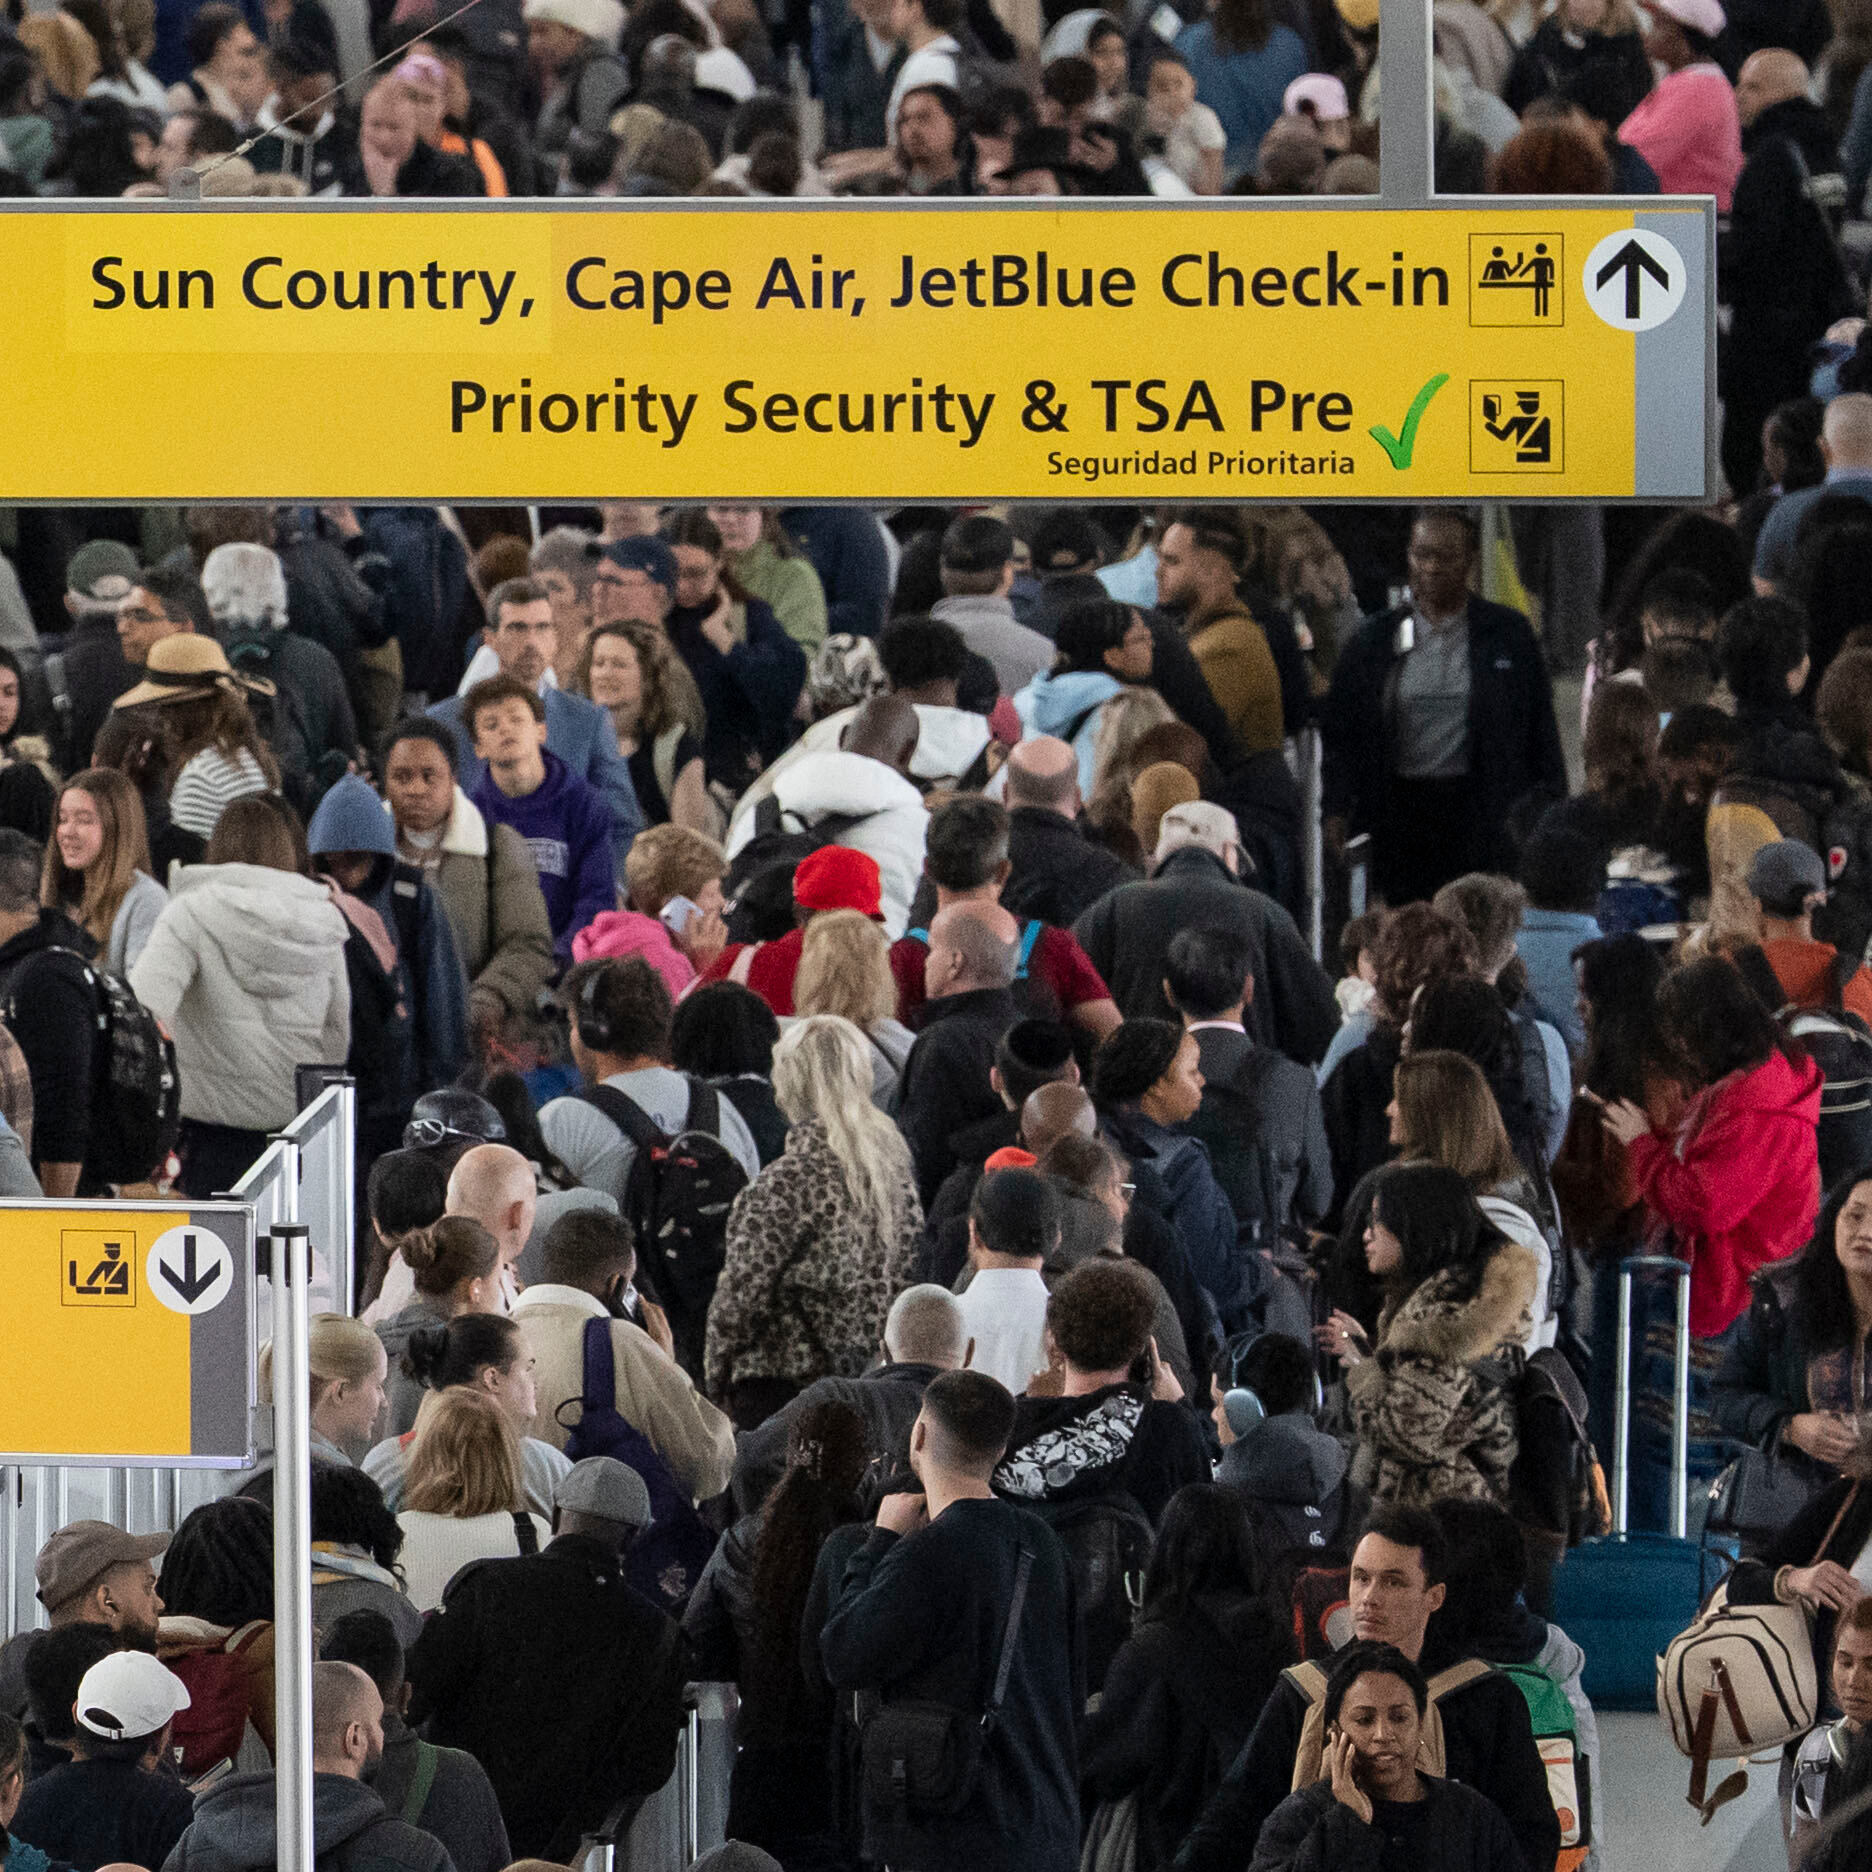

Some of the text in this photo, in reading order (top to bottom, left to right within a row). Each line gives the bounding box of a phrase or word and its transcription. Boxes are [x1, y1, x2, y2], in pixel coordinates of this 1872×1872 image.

[92, 251, 1448, 325] Sun Country, Cape Air, JetBlue Check-in
[452, 378, 1352, 448] Priority Security & TSA Pre
[1048, 450, 1354, 481] Seguridad Prioritaria
